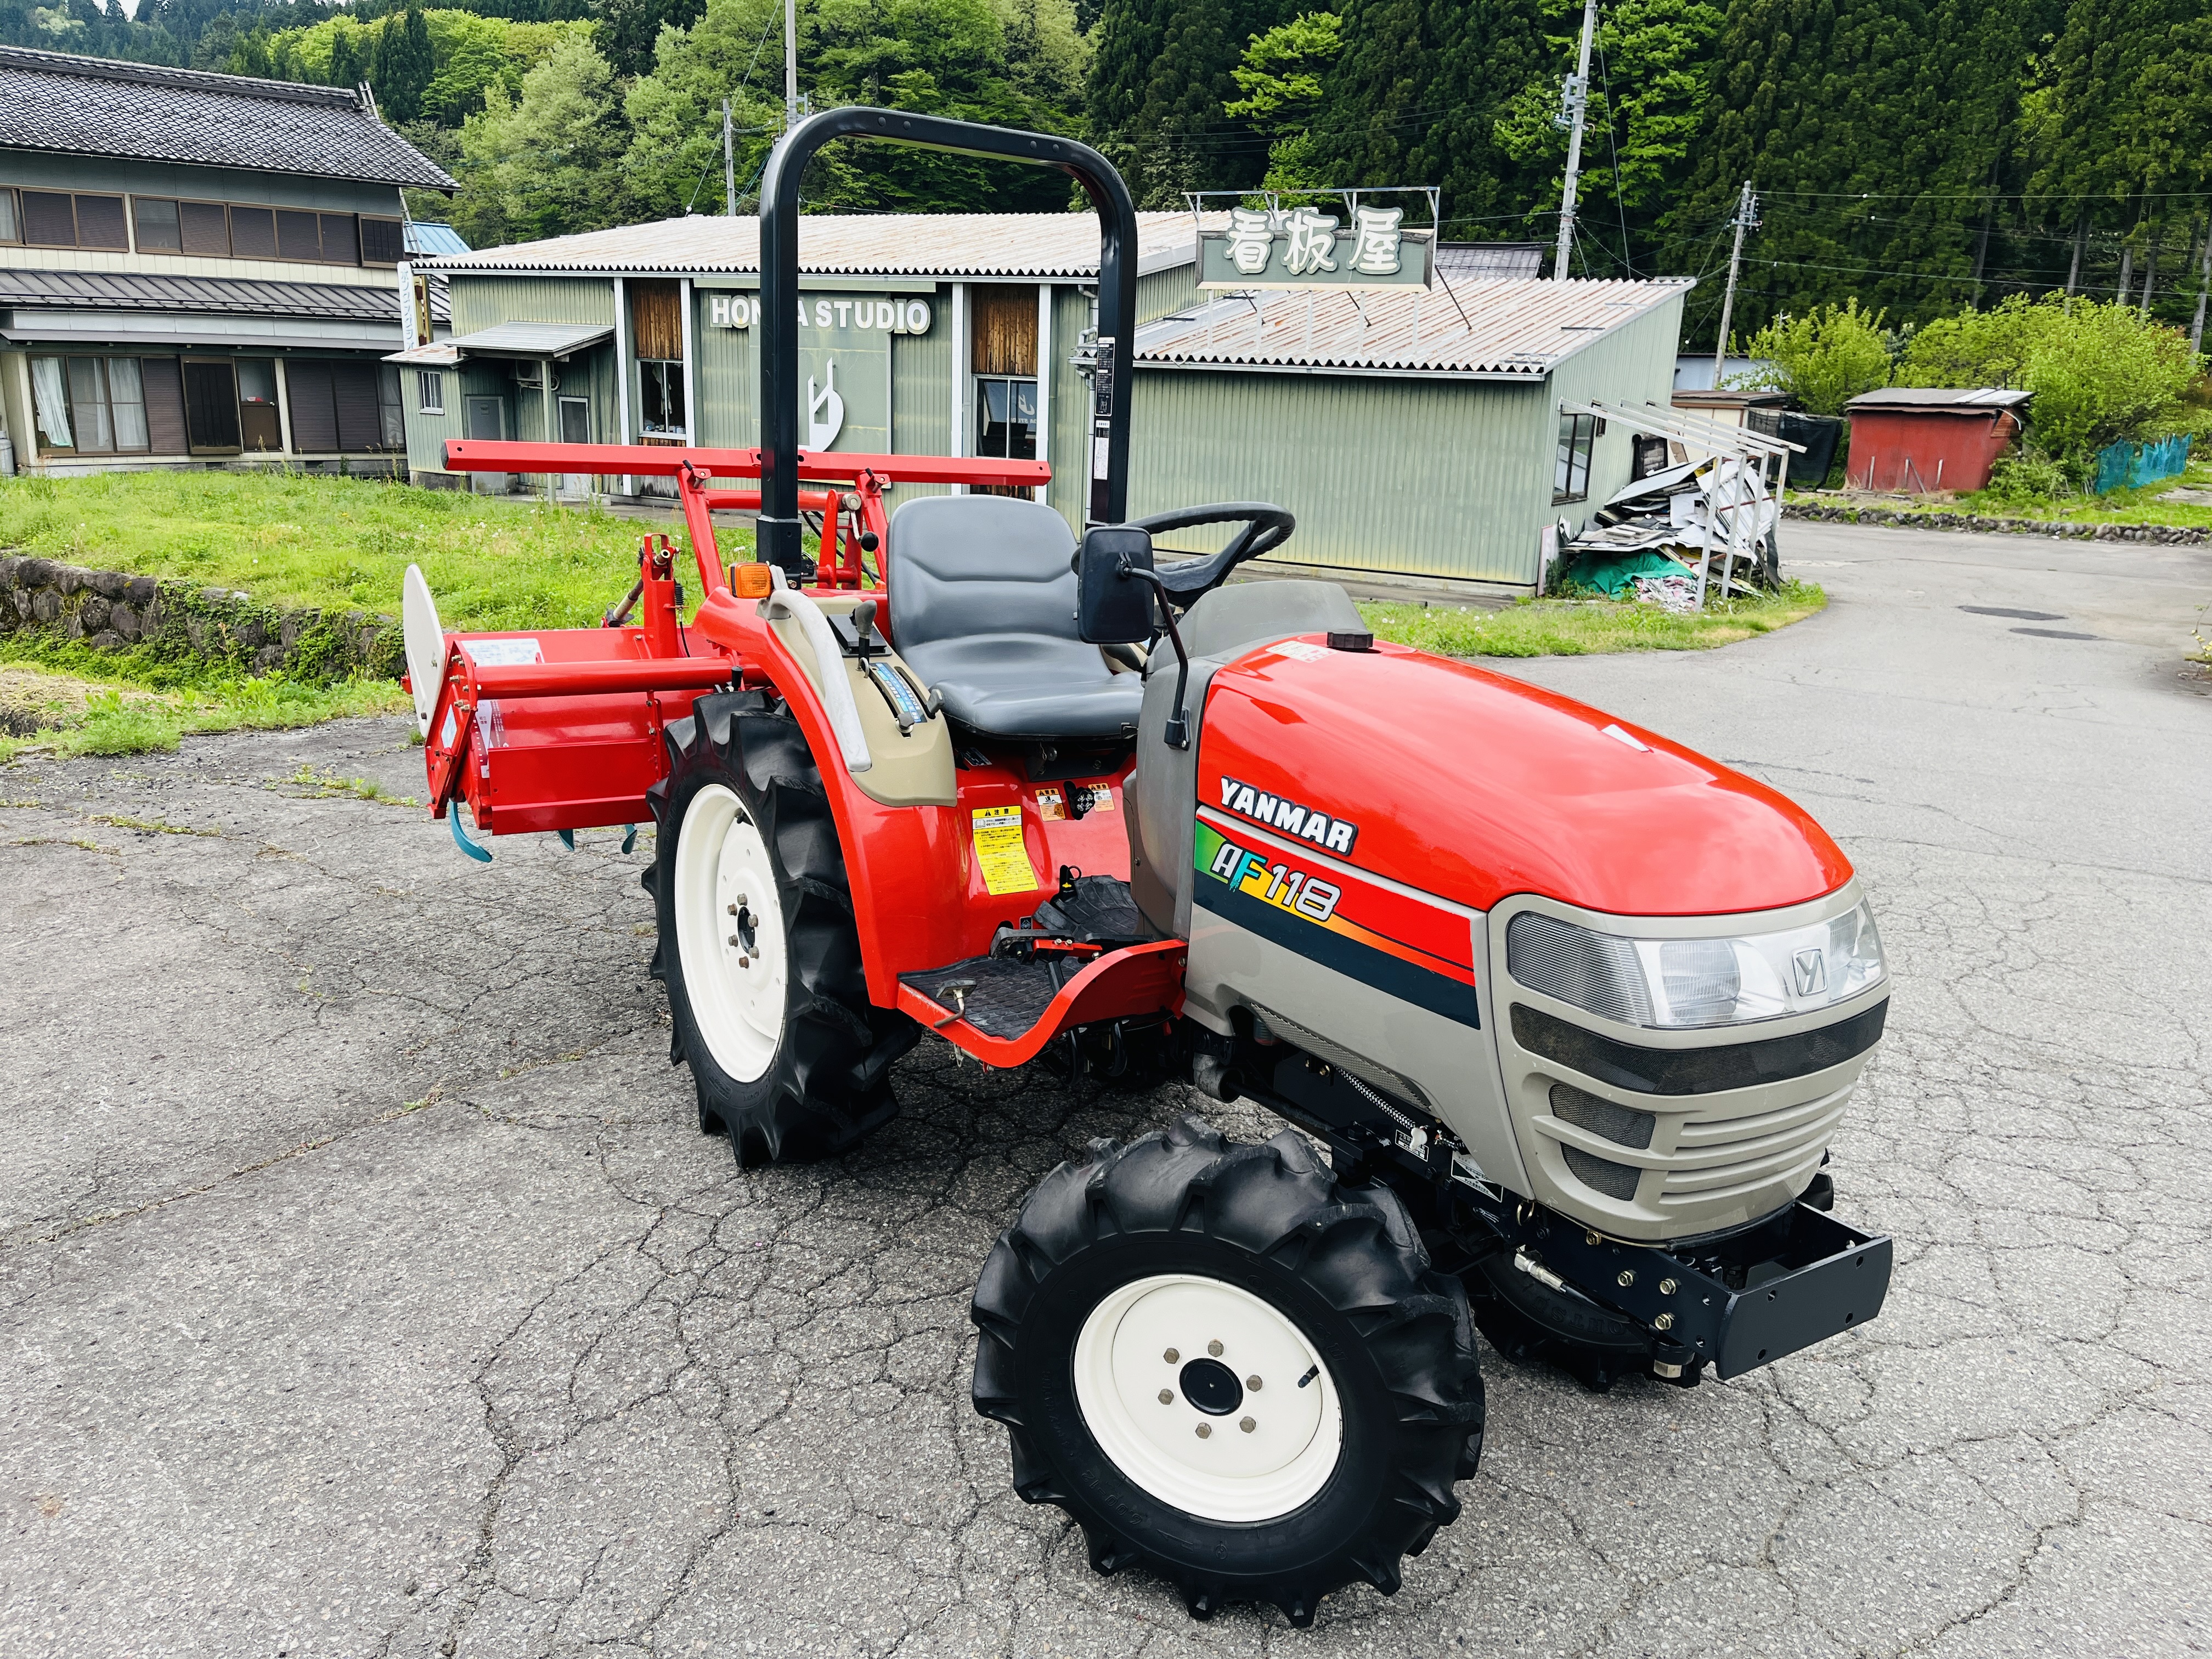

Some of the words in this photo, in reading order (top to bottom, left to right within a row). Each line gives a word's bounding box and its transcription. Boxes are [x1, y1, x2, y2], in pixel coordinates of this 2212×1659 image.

[1225, 206, 1402, 273] 看板屋
[712, 298, 809, 326] HONA
[815, 300, 928, 330] STUDIO
[1221, 776, 1357, 855] YANMAR
[1210, 843, 1342, 922] AF118
